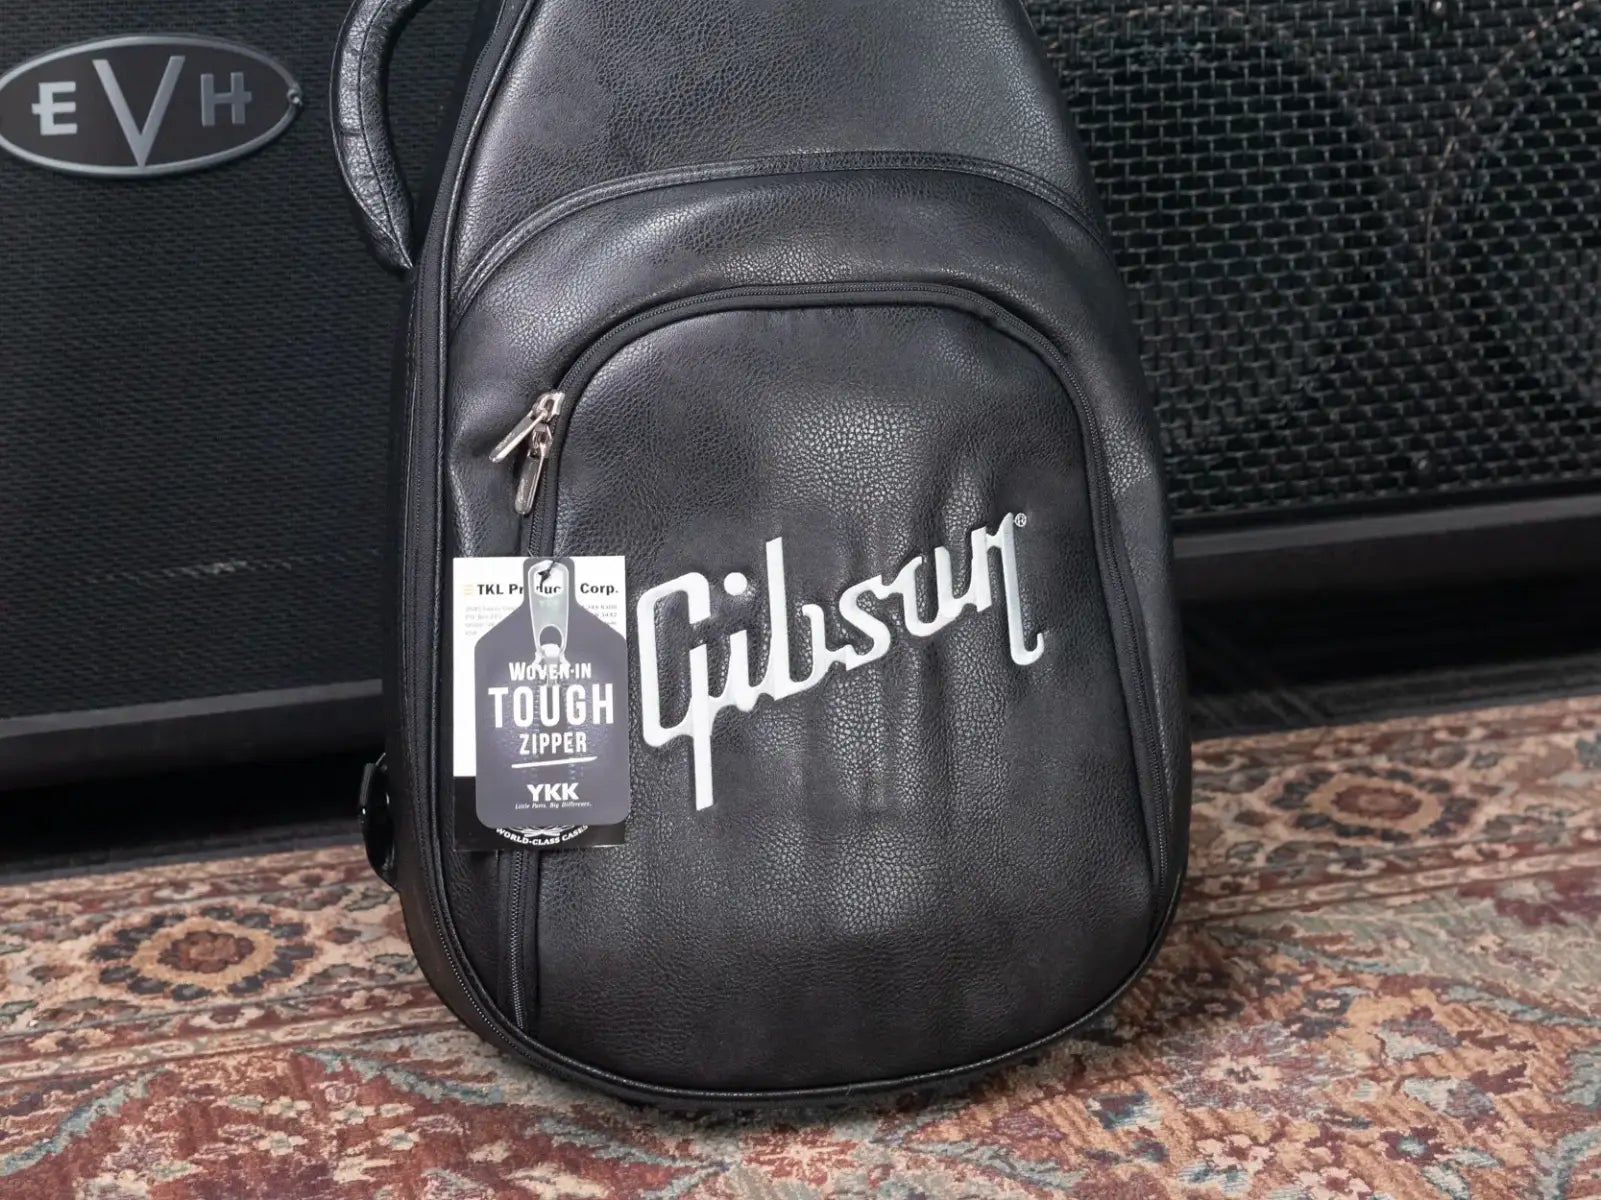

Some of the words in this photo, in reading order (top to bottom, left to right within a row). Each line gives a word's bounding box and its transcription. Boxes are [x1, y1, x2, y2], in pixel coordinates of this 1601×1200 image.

[31, 55, 252, 170] EVH
[477, 583, 504, 596] TKL
[580, 582, 619, 596] Corp.
[636, 512, 1045, 812] Gibson
[488, 682, 614, 729] TOUGH
[518, 730, 588, 756] ZIPPER
[526, 782, 580, 802] YKK
